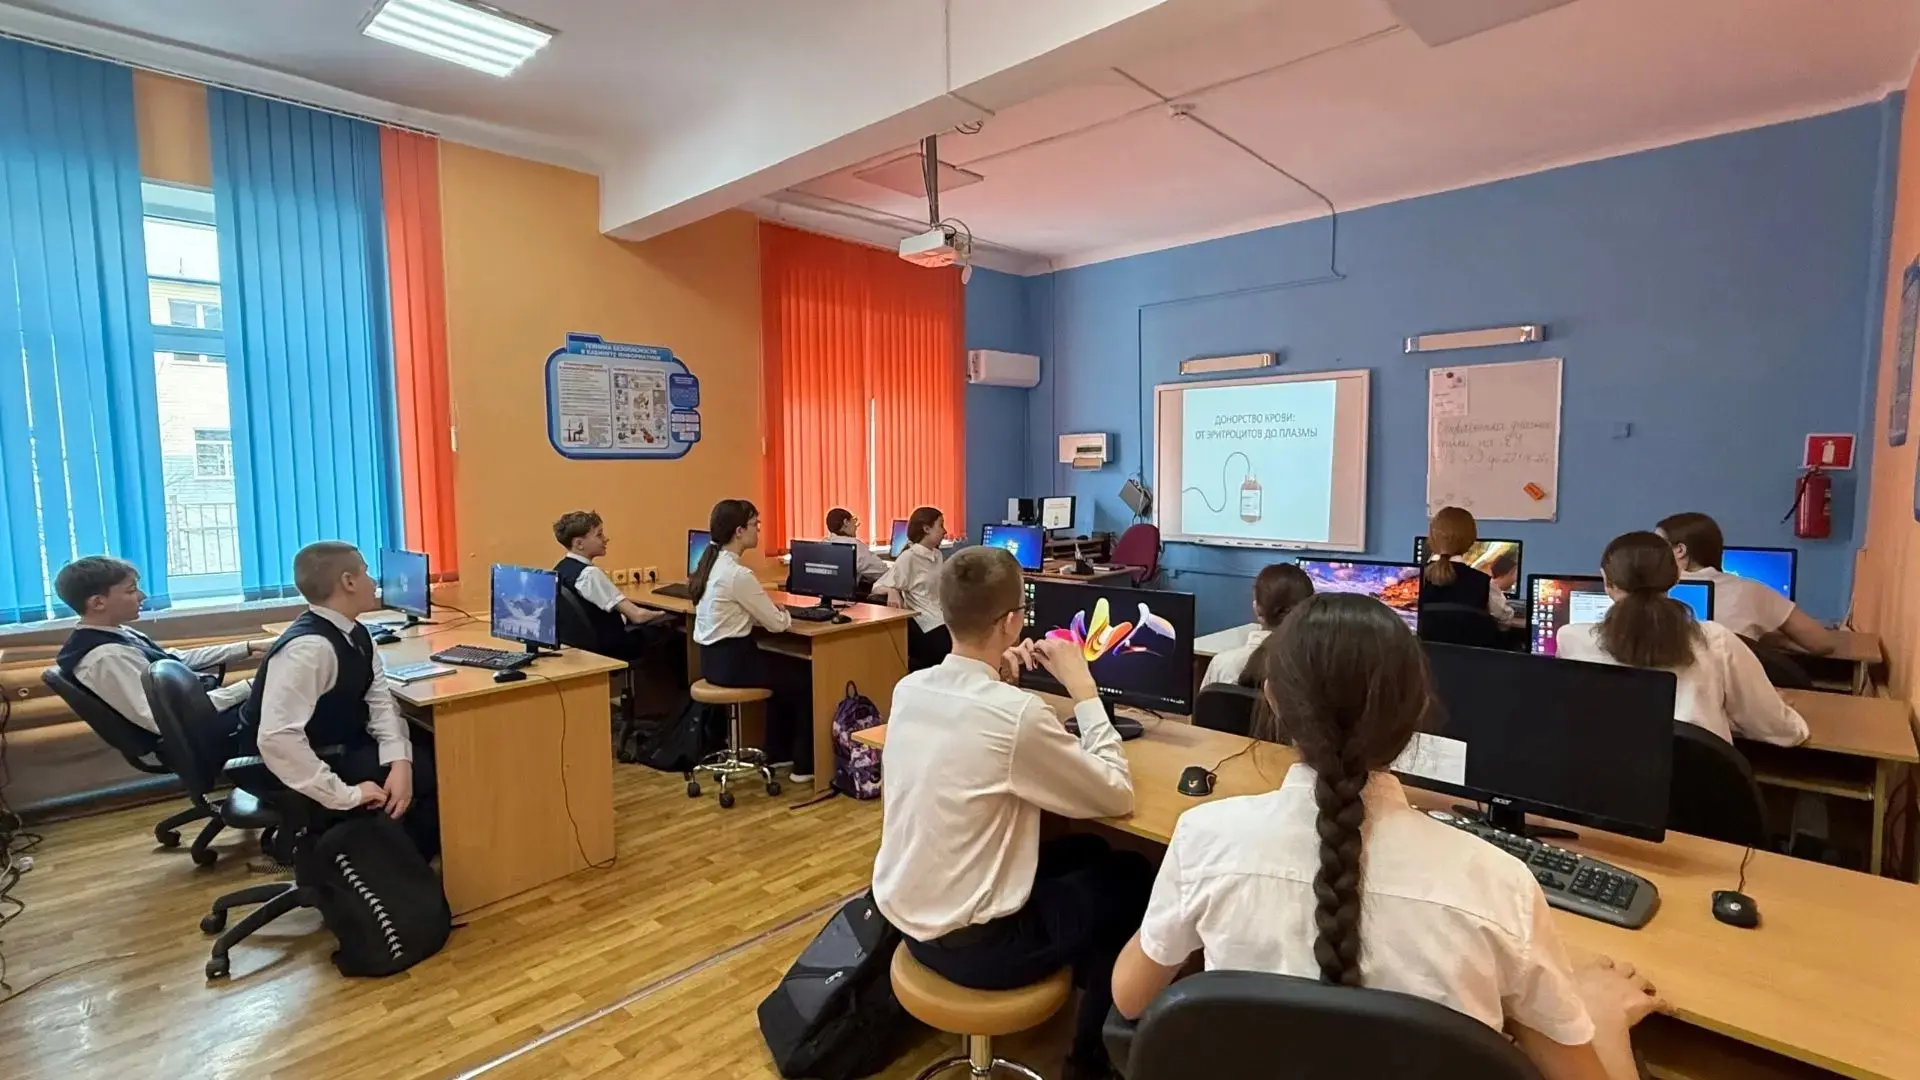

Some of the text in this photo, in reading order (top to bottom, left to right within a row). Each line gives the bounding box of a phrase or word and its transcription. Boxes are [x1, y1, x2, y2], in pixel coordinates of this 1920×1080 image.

[1214, 412, 1296, 426] ДОНОРСТВО КРОВИ:
[1195, 427, 1318, 441] ОТ ЭРИТРОЦИТОВ ДО ПЛАЗМЫ
